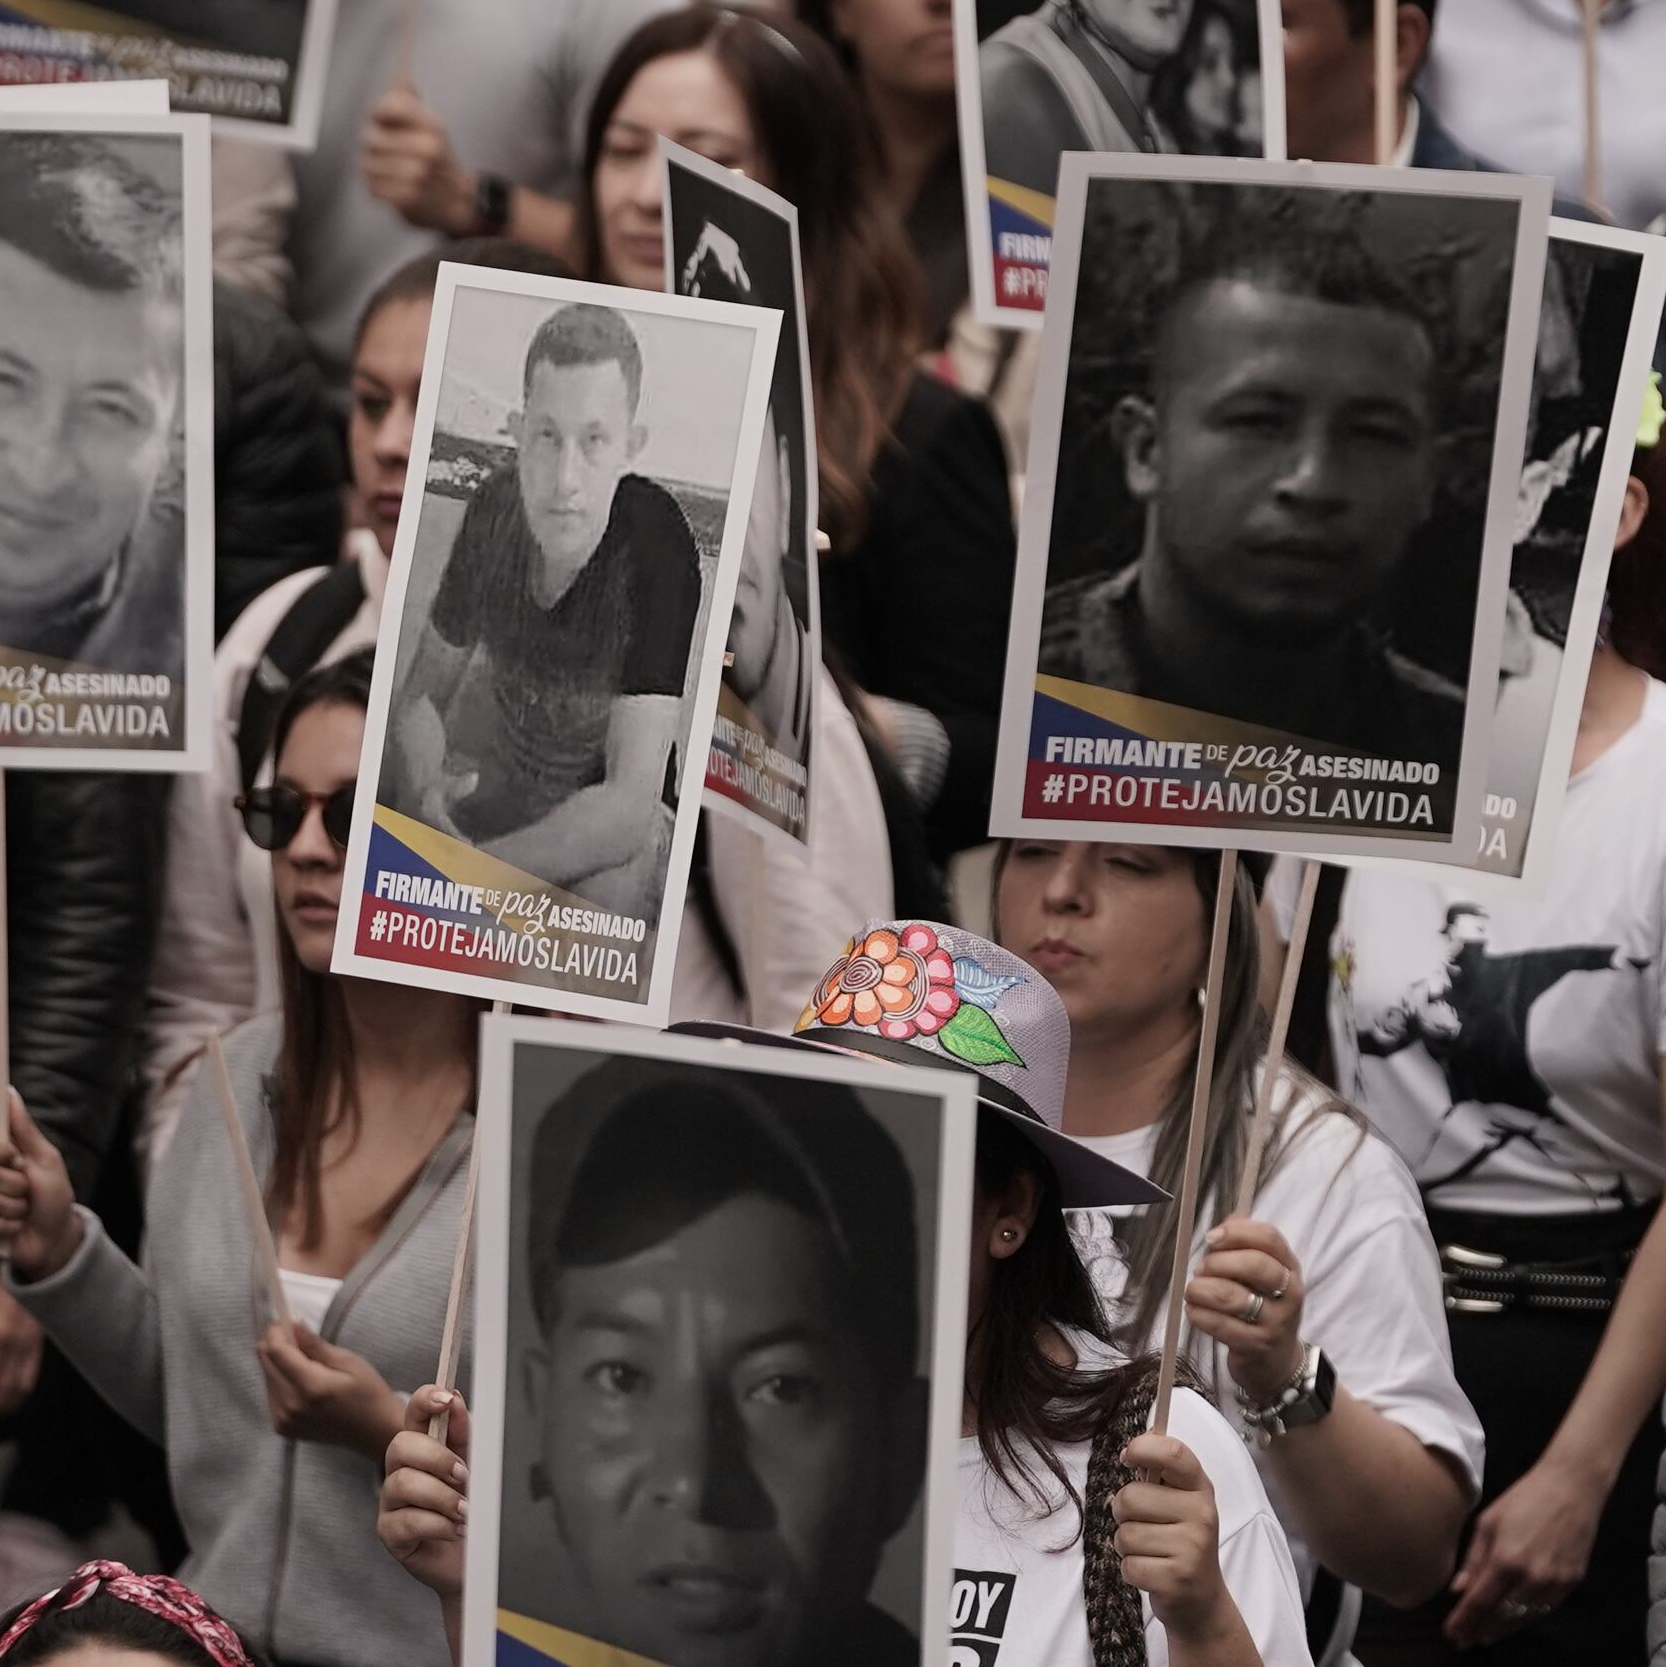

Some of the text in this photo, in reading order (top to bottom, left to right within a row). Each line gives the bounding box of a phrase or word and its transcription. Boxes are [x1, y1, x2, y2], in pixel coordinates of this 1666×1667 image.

[44, 674, 171, 697] ASESINADO
[707, 745, 805, 828] OTEJAMOSLAVIDA
[1045, 736, 1440, 785] FIRMANTE DE paz ASESINADO
[1042, 773, 1434, 825] #PROTEJAMOSLAVIDA
[375, 870, 646, 943] FIRMANTE DE paz ASESINADO
[370, 910, 637, 985] #PROTEJAMOSLAVIDA
